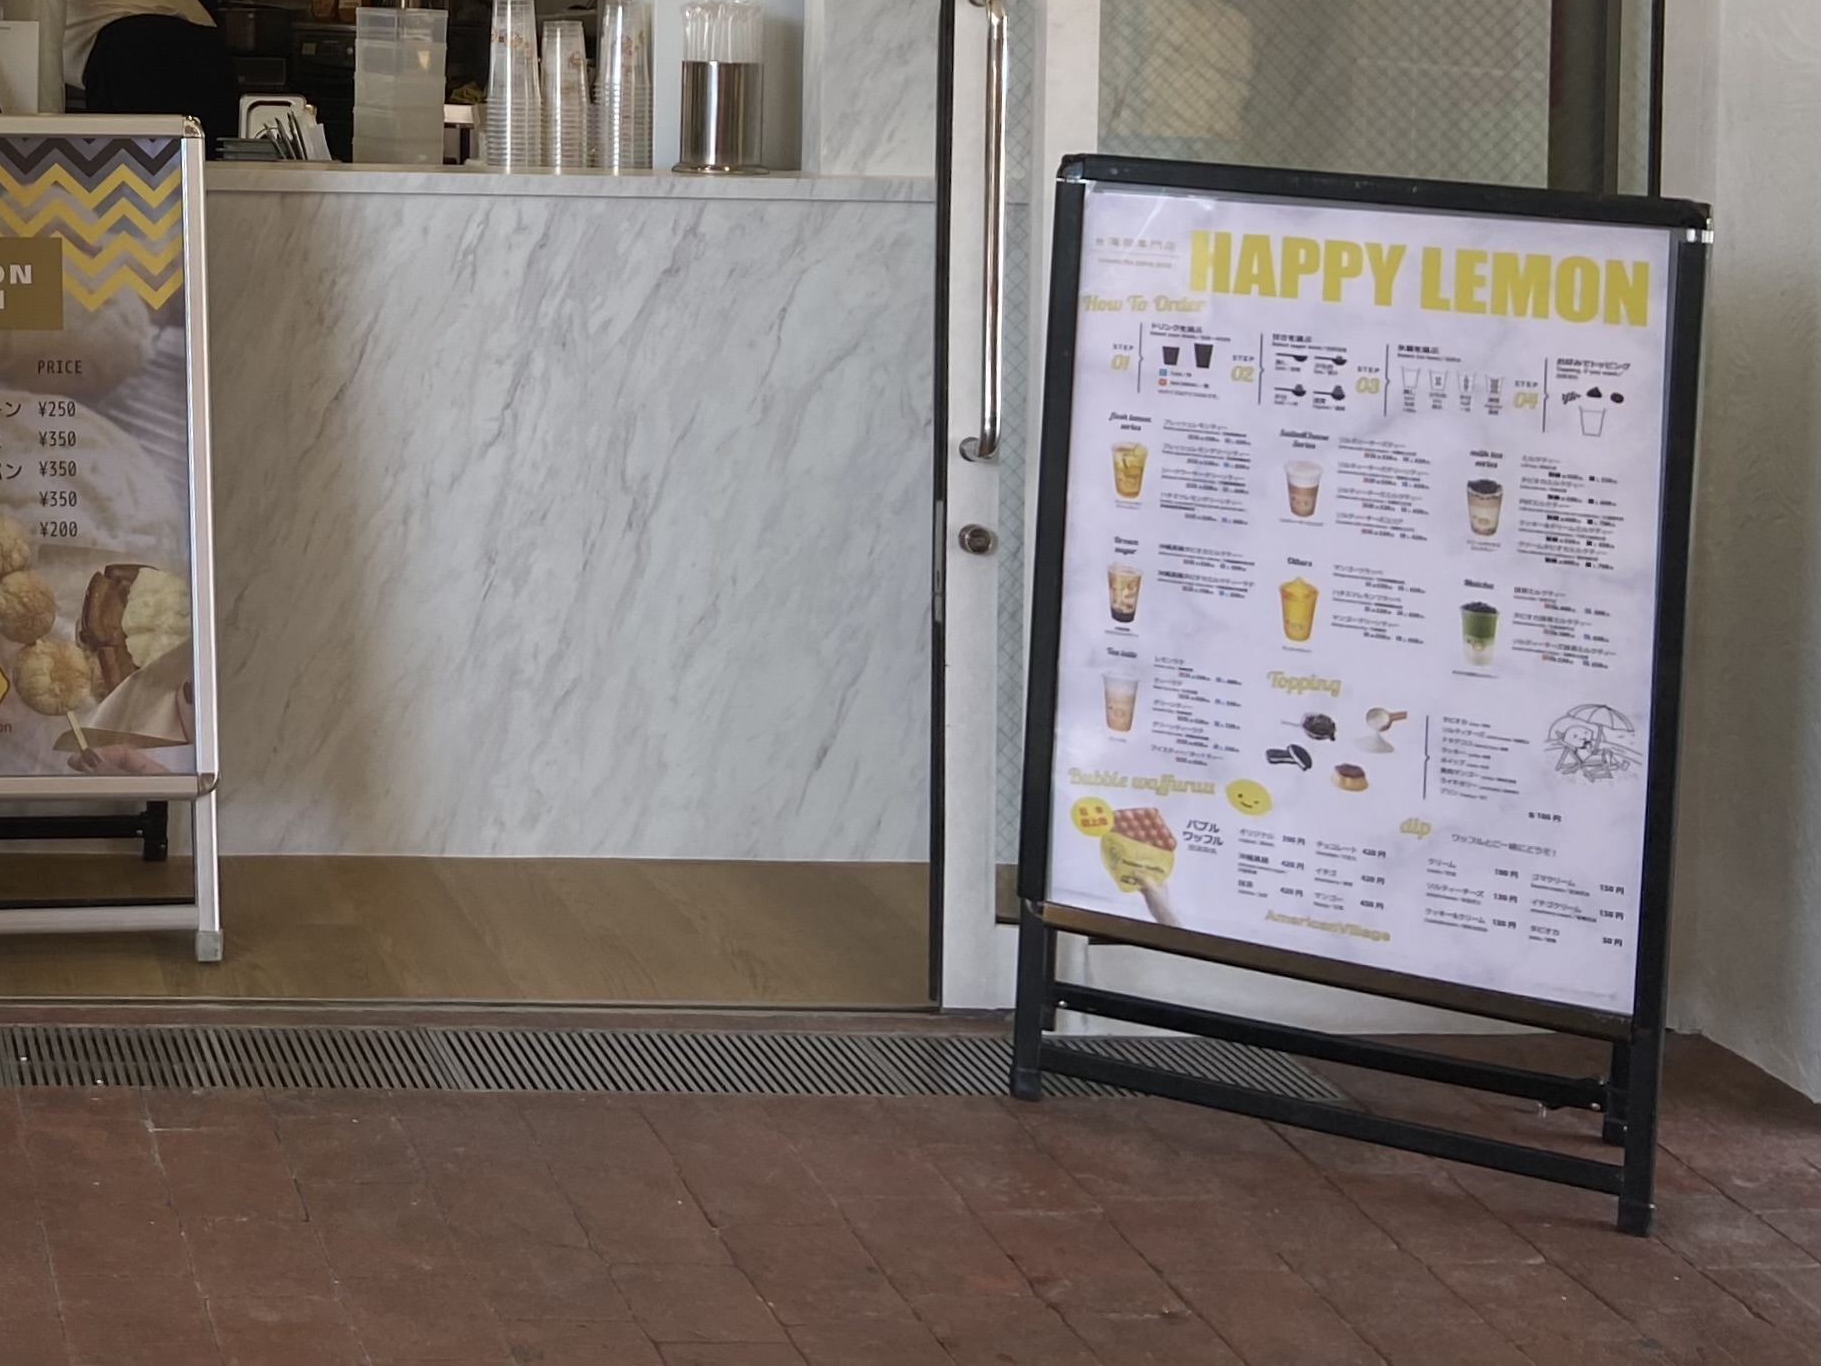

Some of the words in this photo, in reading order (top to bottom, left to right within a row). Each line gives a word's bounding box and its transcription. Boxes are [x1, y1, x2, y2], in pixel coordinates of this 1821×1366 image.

[1190, 229, 1407, 307] HAPPY
[1420, 246, 1650, 327] LEMON
[1083, 295, 1123, 313] How
[1126, 295, 1148, 313] To
[1153, 295, 1206, 314] Order
[1113, 343, 1135, 352] STEP
[36, 360, 84, 375] PRICE
[1232, 354, 1255, 363] STEP
[1357, 365, 1381, 374] STEP
[37, 400, 77, 418] ¥250
[38, 430, 78, 448] ¥350
[38, 460, 78, 478] ¥350
[39, 490, 78, 508] ¥350
[39, 520, 78, 538] ¥200
[1186, 819, 1220, 834] バブル
[1182, 831, 1224, 846] ワッフル
